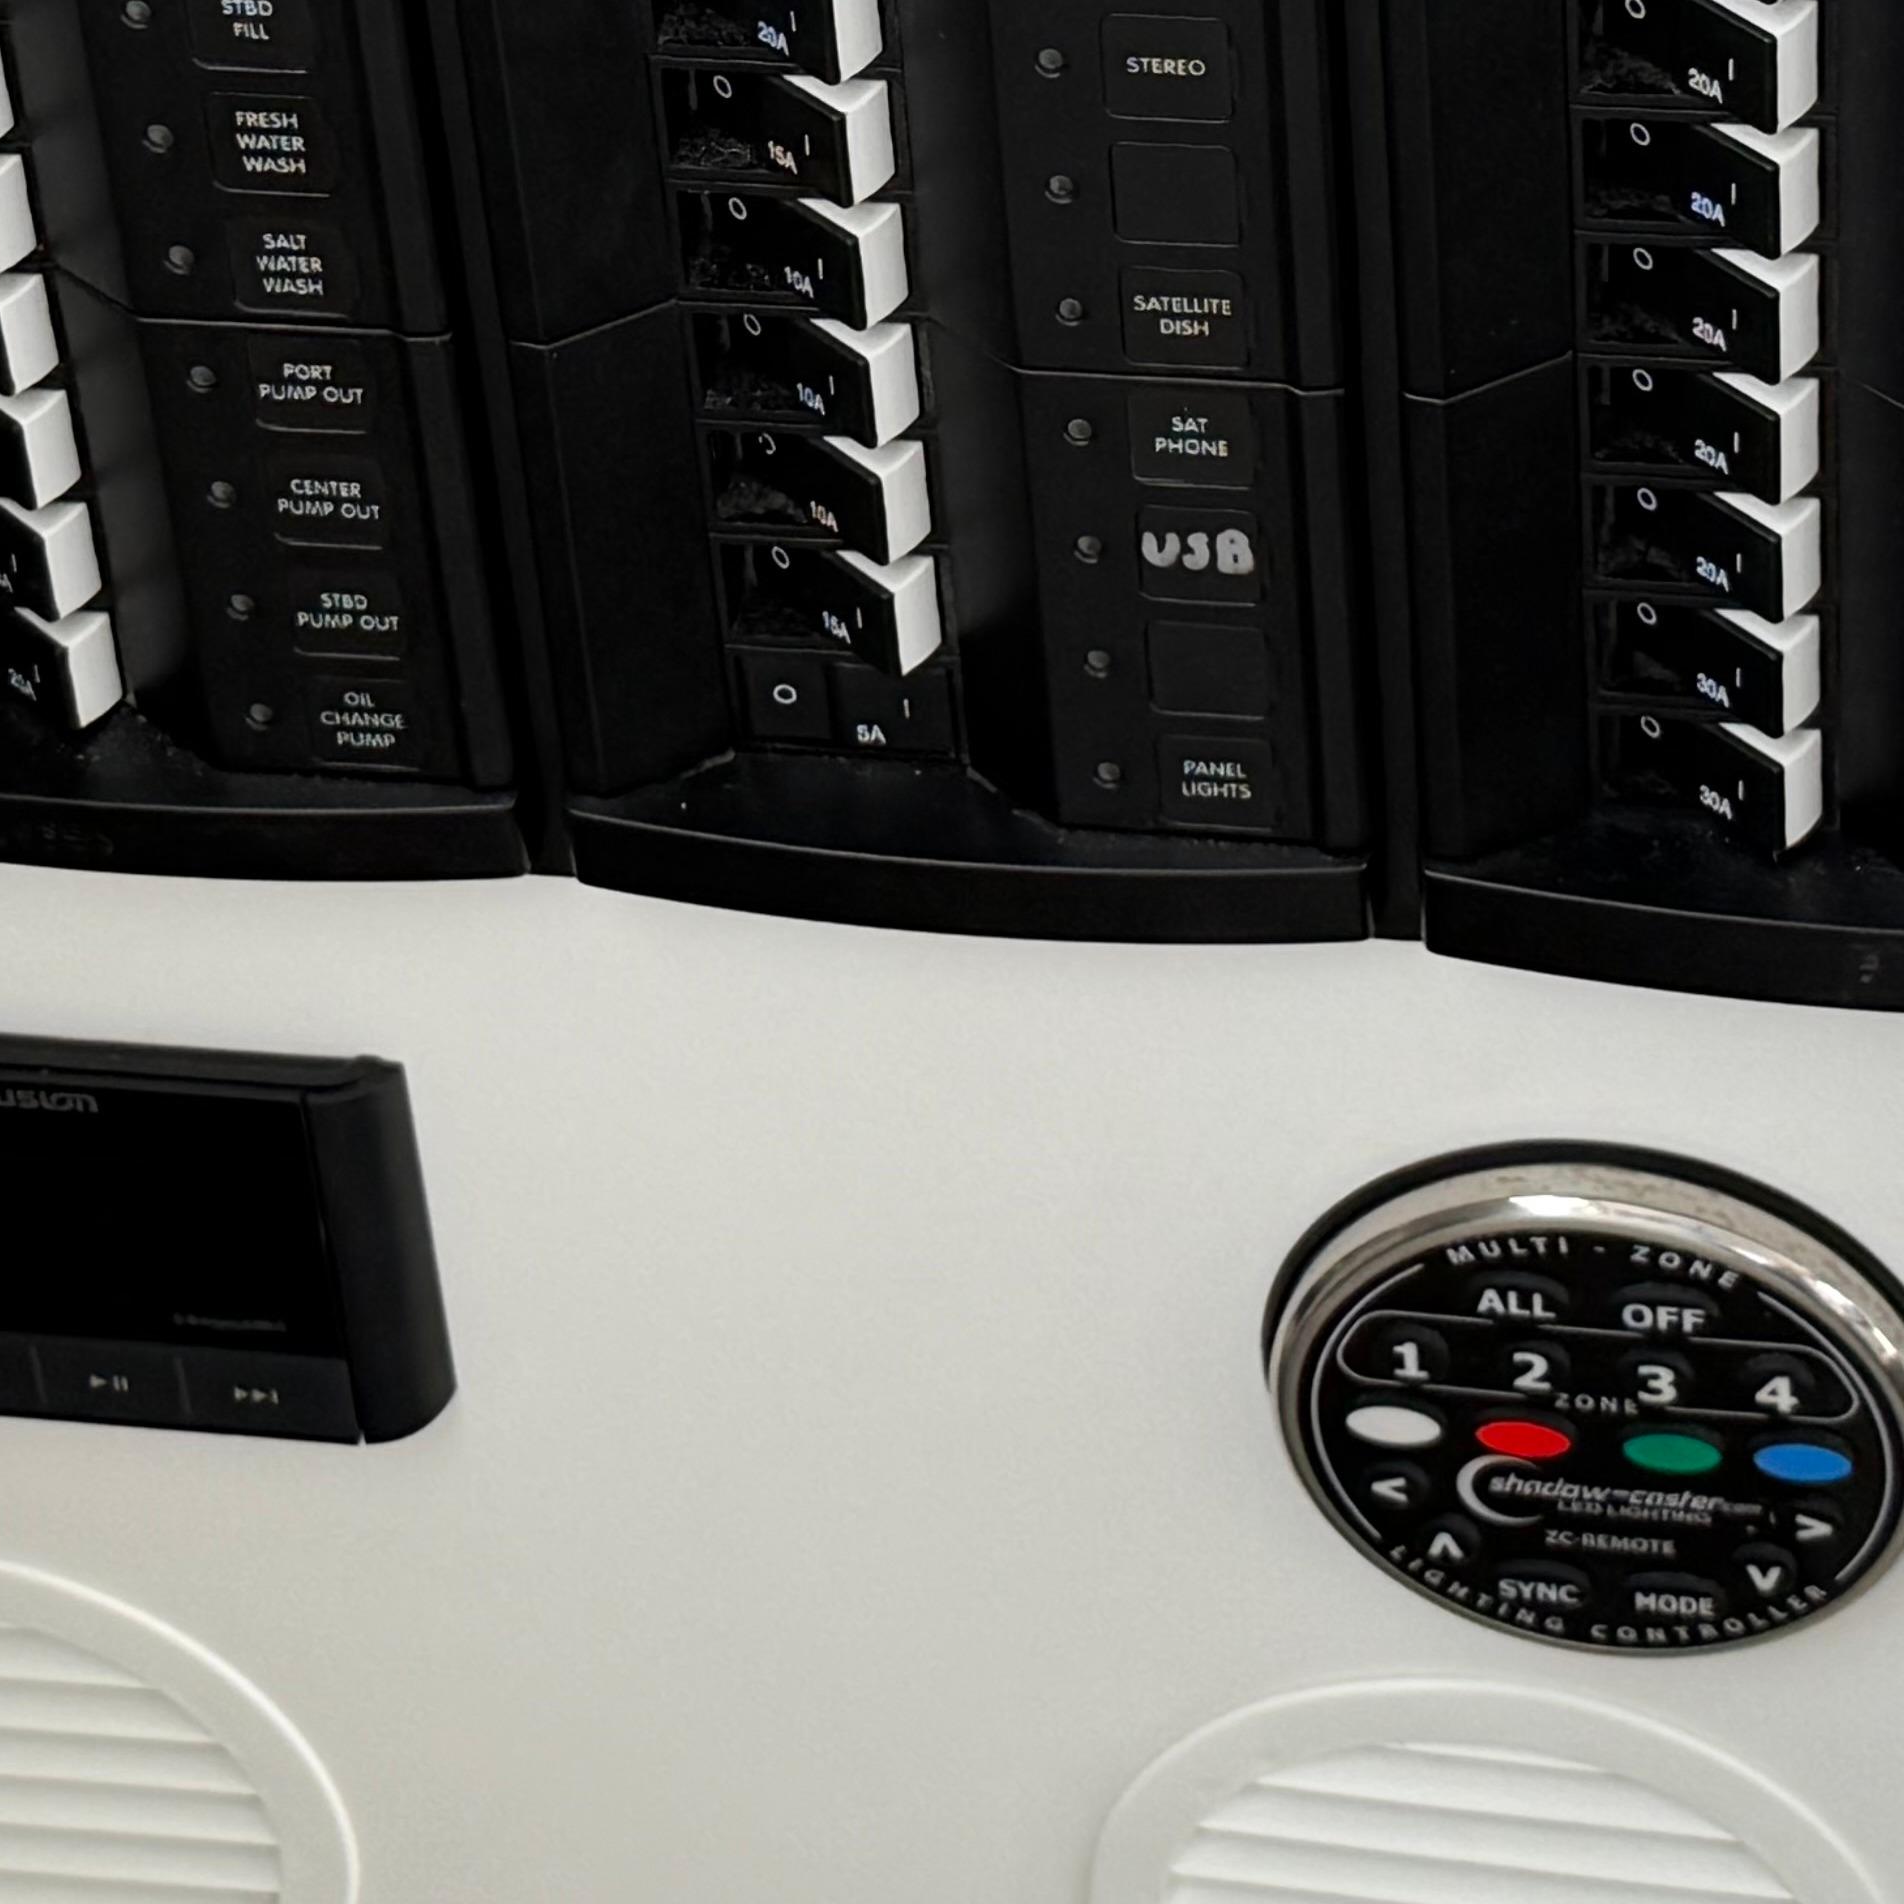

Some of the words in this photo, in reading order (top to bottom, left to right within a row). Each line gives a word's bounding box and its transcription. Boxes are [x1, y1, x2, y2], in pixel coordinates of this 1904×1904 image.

[233, 22, 269, 40] FILL
[1127, 57, 1205, 75] STEREO
[236, 111, 298, 129] FRESH
[236, 134, 305, 151] WATER
[243, 156, 306, 173] WASH
[263, 234, 305, 250] SALT
[257, 255, 322, 273] WATER
[263, 277, 323, 295] WASH
[1134, 295, 1231, 315] SATELLITE
[1160, 319, 1209, 336] DISH
[284, 363, 332, 380] PORT
[259, 384, 317, 400] PUMP
[323, 386, 363, 403] OUT
[1172, 417, 1208, 433] SAT
[1155, 437, 1228, 456] PHONE
[290, 479, 361, 498] CENTER
[278, 498, 334, 516] PUMP
[341, 503, 379, 519] OUT
[1142, 529, 1254, 574] USB
[321, 593, 367, 610] STBD
[297, 612, 353, 628] PUMP
[360, 615, 398, 631] OUT
[344, 692, 374, 707] OIL
[320, 711, 404, 729] CHANGE
[337, 732, 395, 747] PUMP
[1184, 760, 1246, 778] PANEL
[1182, 782, 1251, 799] LIGHTS
[1446, 1235, 1571, 1267] MULTI
[1631, 1245, 1740, 1289] ZONE
[1476, 1288, 1557, 1320] ALL
[1621, 1305, 1706, 1334] OFF
[1392, 1343, 1428, 1377] 1
[1511, 1352, 1554, 1391] 2
[1637, 1365, 1677, 1404] 3
[1755, 1377, 1798, 1414] 4
[1555, 1392, 1640, 1414] ZONE
[1498, 1577, 1580, 1606] SYNC
[1634, 1591, 1716, 1617] MODE
